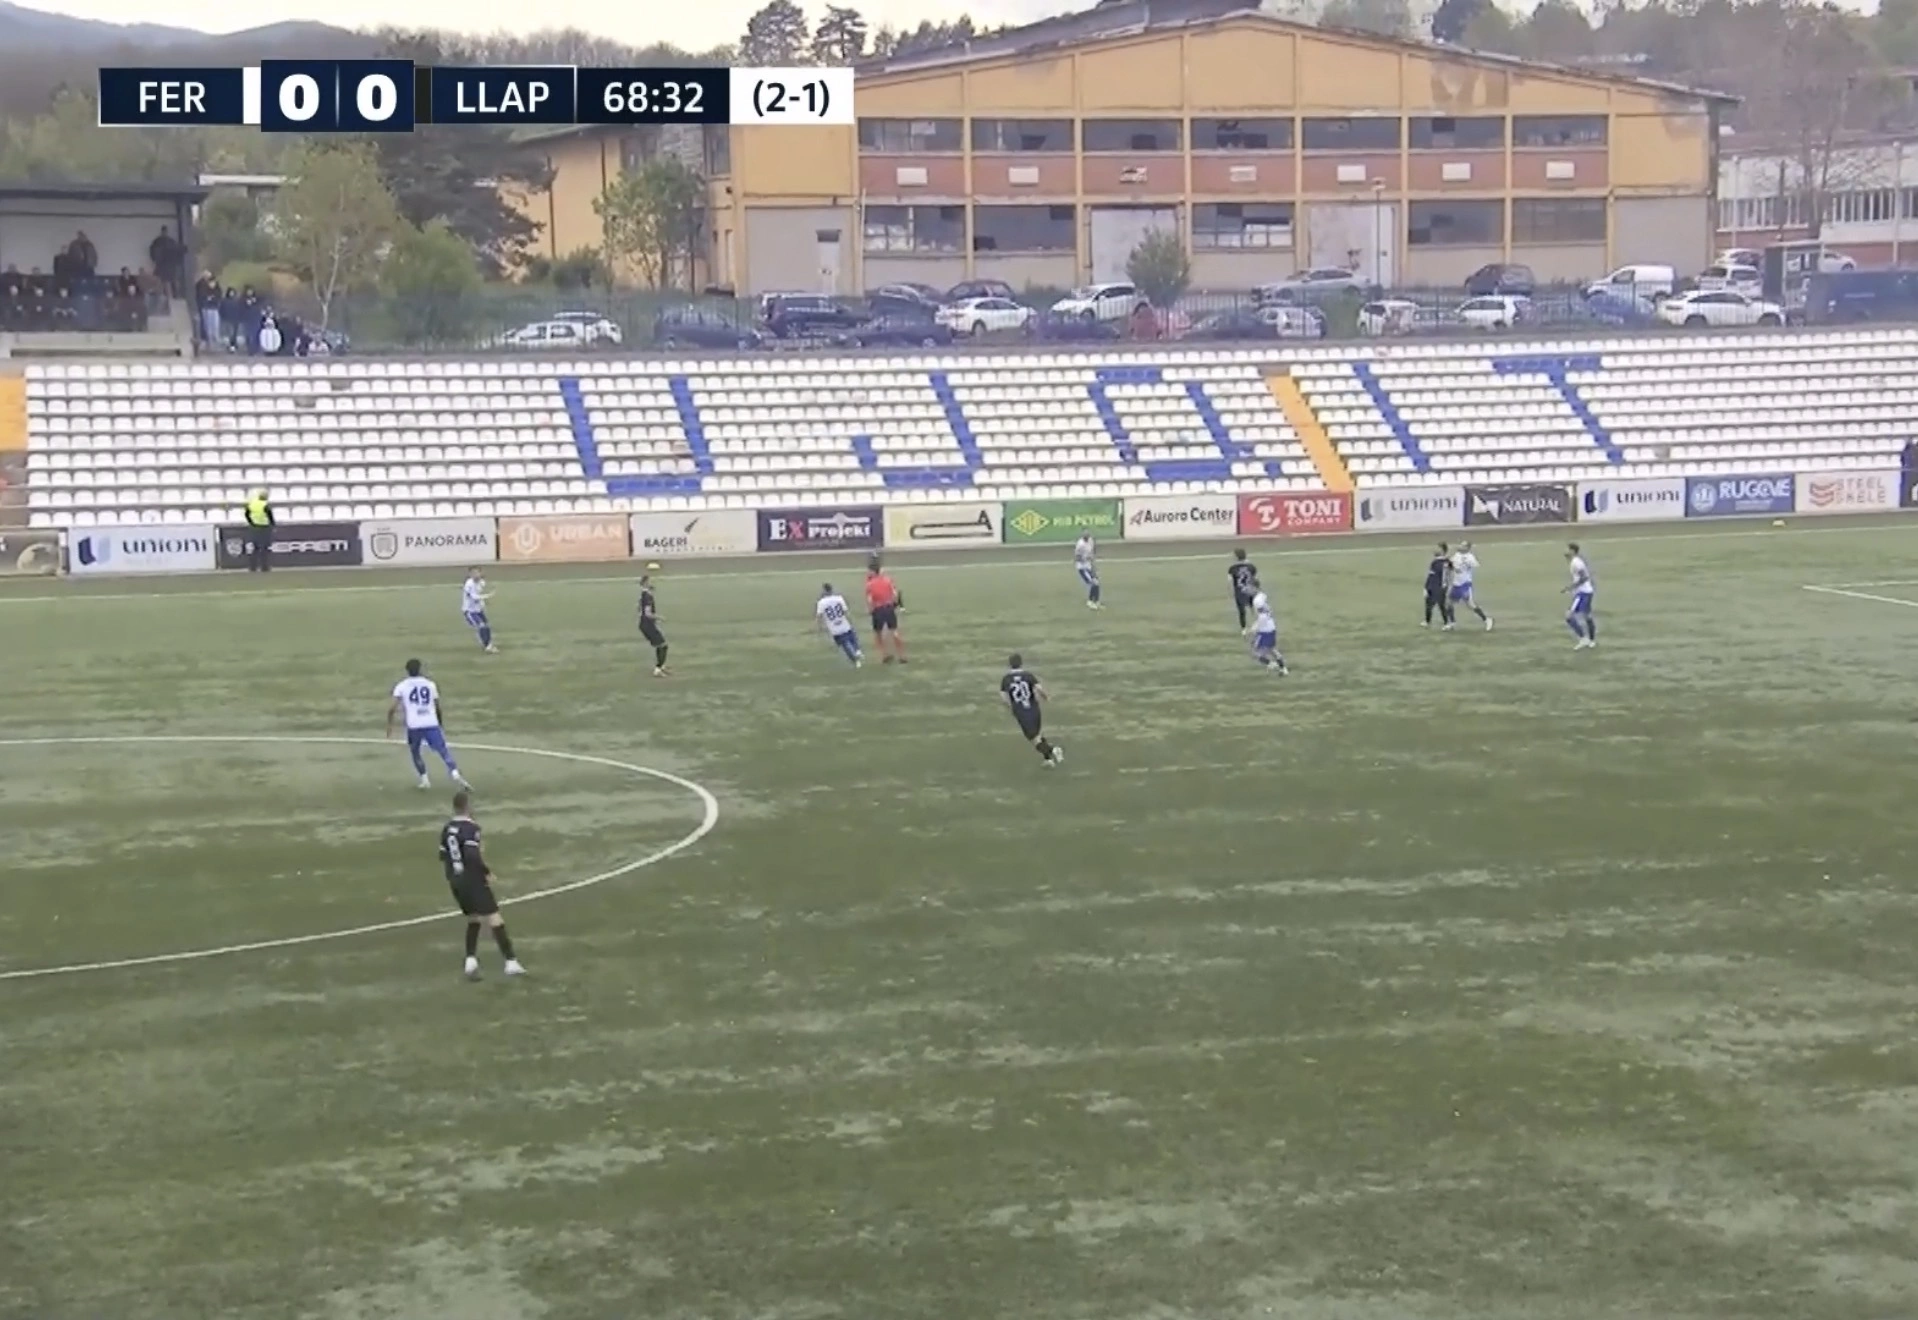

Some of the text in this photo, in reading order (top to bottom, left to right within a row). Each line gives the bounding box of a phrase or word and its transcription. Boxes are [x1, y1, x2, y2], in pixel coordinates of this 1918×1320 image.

[1190, 506, 1235, 521] Center
[1283, 499, 1342, 519] TONI
[1502, 499, 1561, 512] NATURAL
[404, 533, 488, 548] PANORAMA
[409, 686, 431, 706] 49
[1009, 681, 1031, 703] 20
